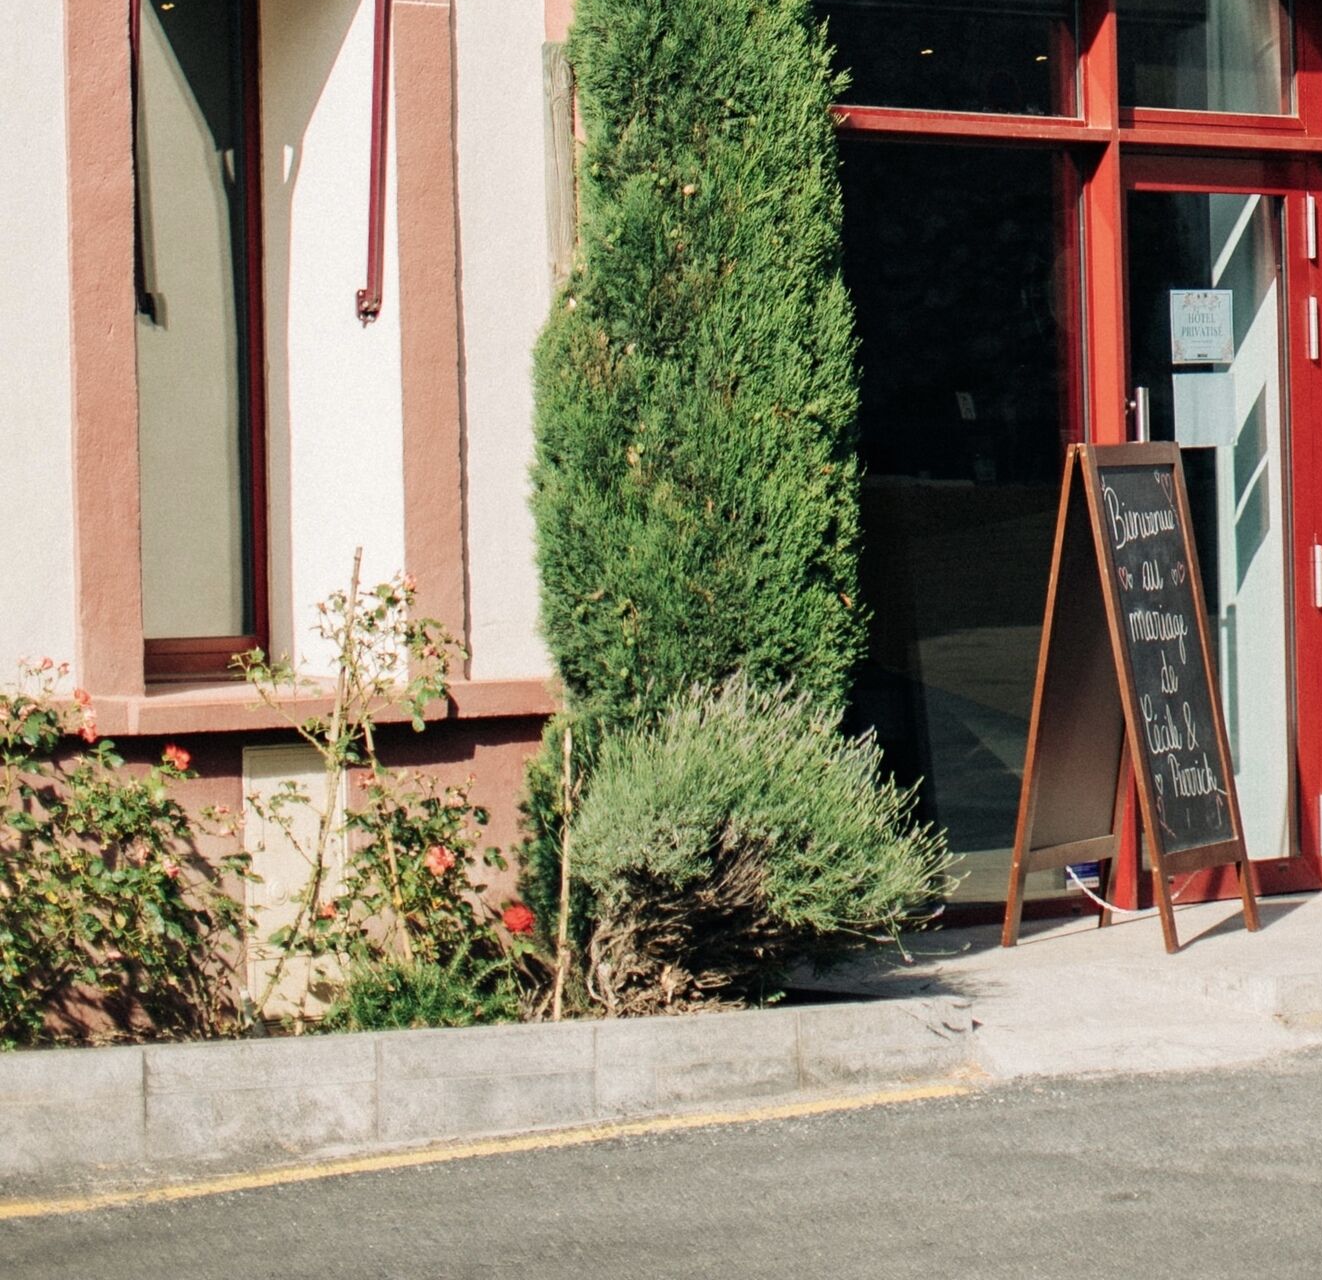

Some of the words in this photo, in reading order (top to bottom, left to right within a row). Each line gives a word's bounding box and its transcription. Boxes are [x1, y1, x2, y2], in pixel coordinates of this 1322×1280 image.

[1103, 486, 1176, 550] Bienvenue
[1142, 560, 1164, 591] au
[1129, 604, 1188, 665] mariage
[1161, 649, 1179, 695] de
[1183, 701, 1200, 751] &
